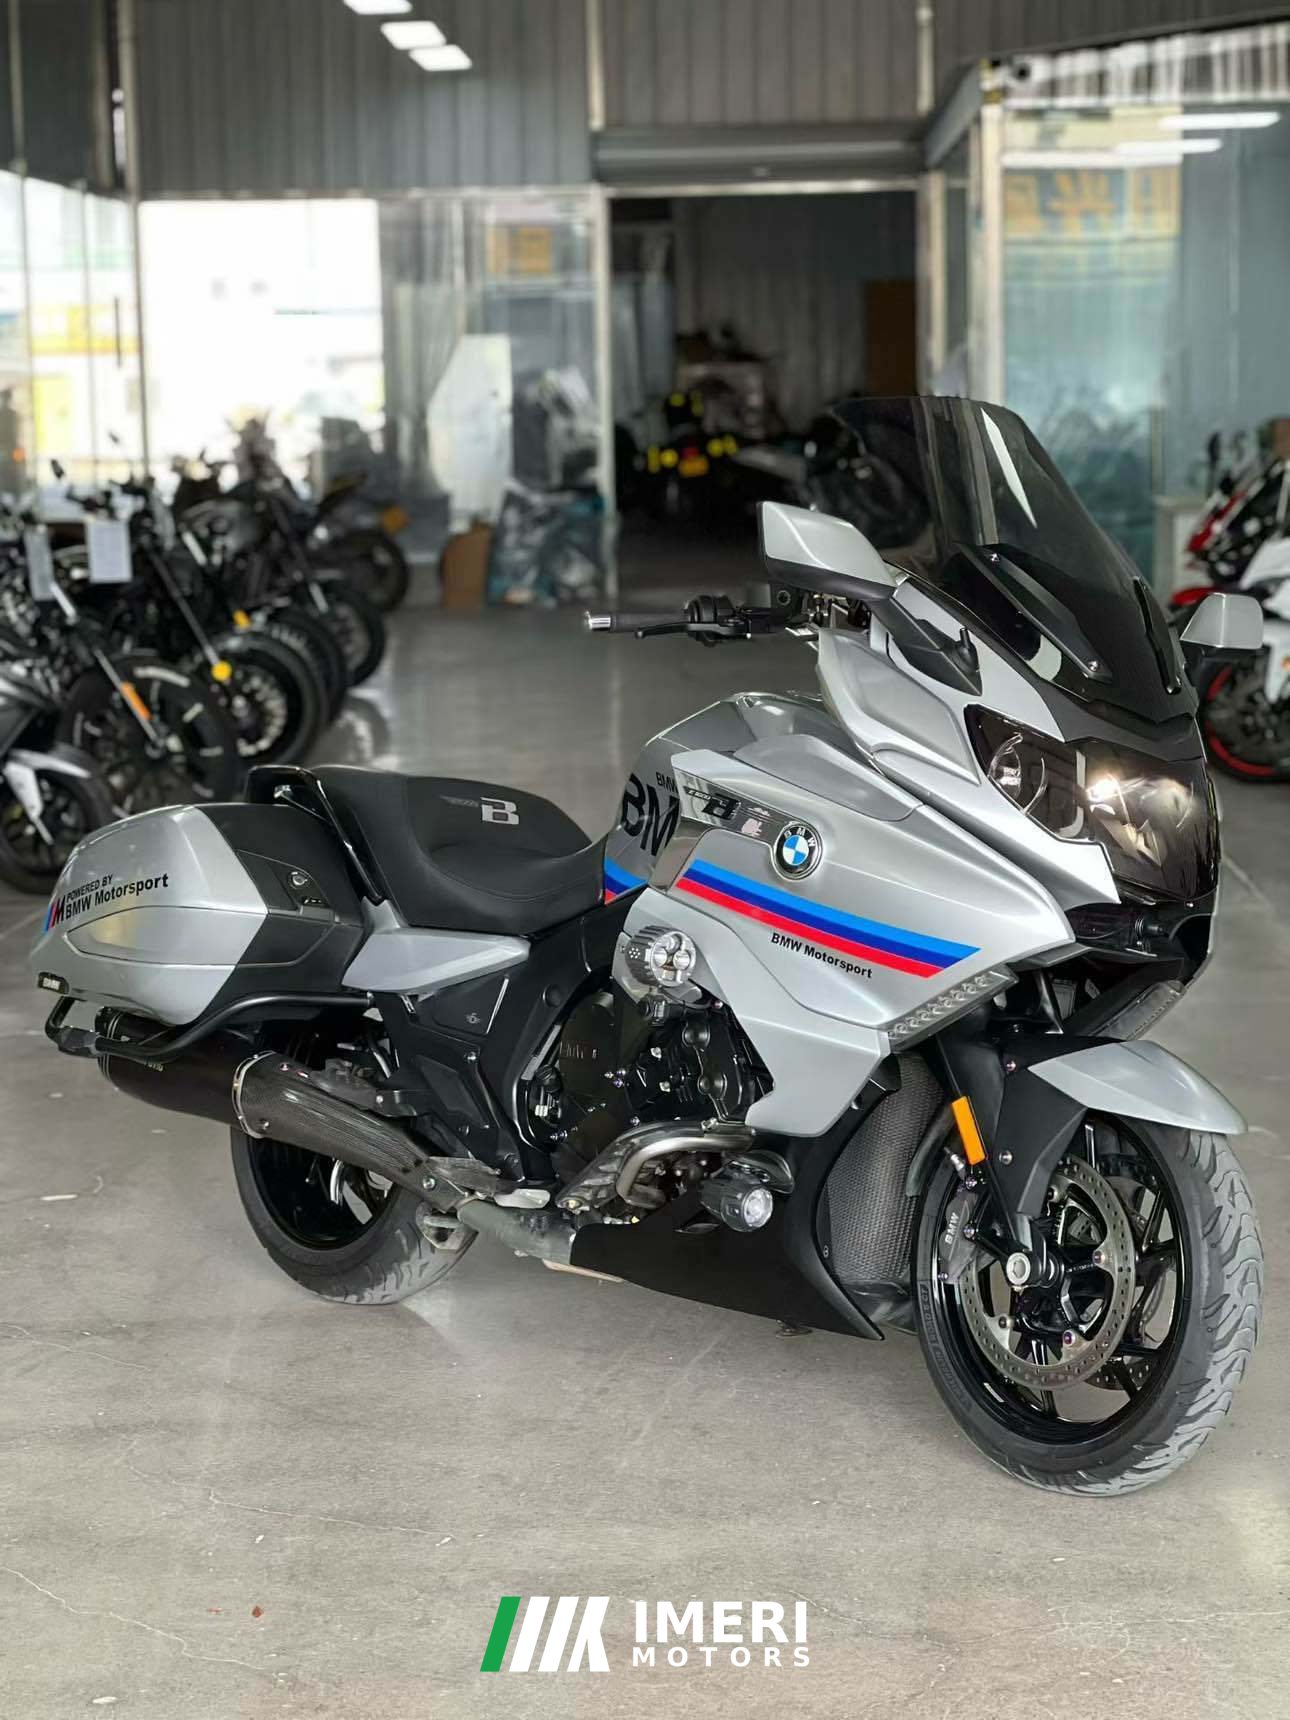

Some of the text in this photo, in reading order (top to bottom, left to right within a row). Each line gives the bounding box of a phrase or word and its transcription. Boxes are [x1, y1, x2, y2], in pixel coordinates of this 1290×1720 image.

[784, 827, 816, 847] BMW
[65, 873, 169, 920] BMW Motorsport
[66, 874, 113, 903] POWERED BY
[770, 932, 873, 979] BMW Motorsport
[944, 1211, 960, 1245] BMW
